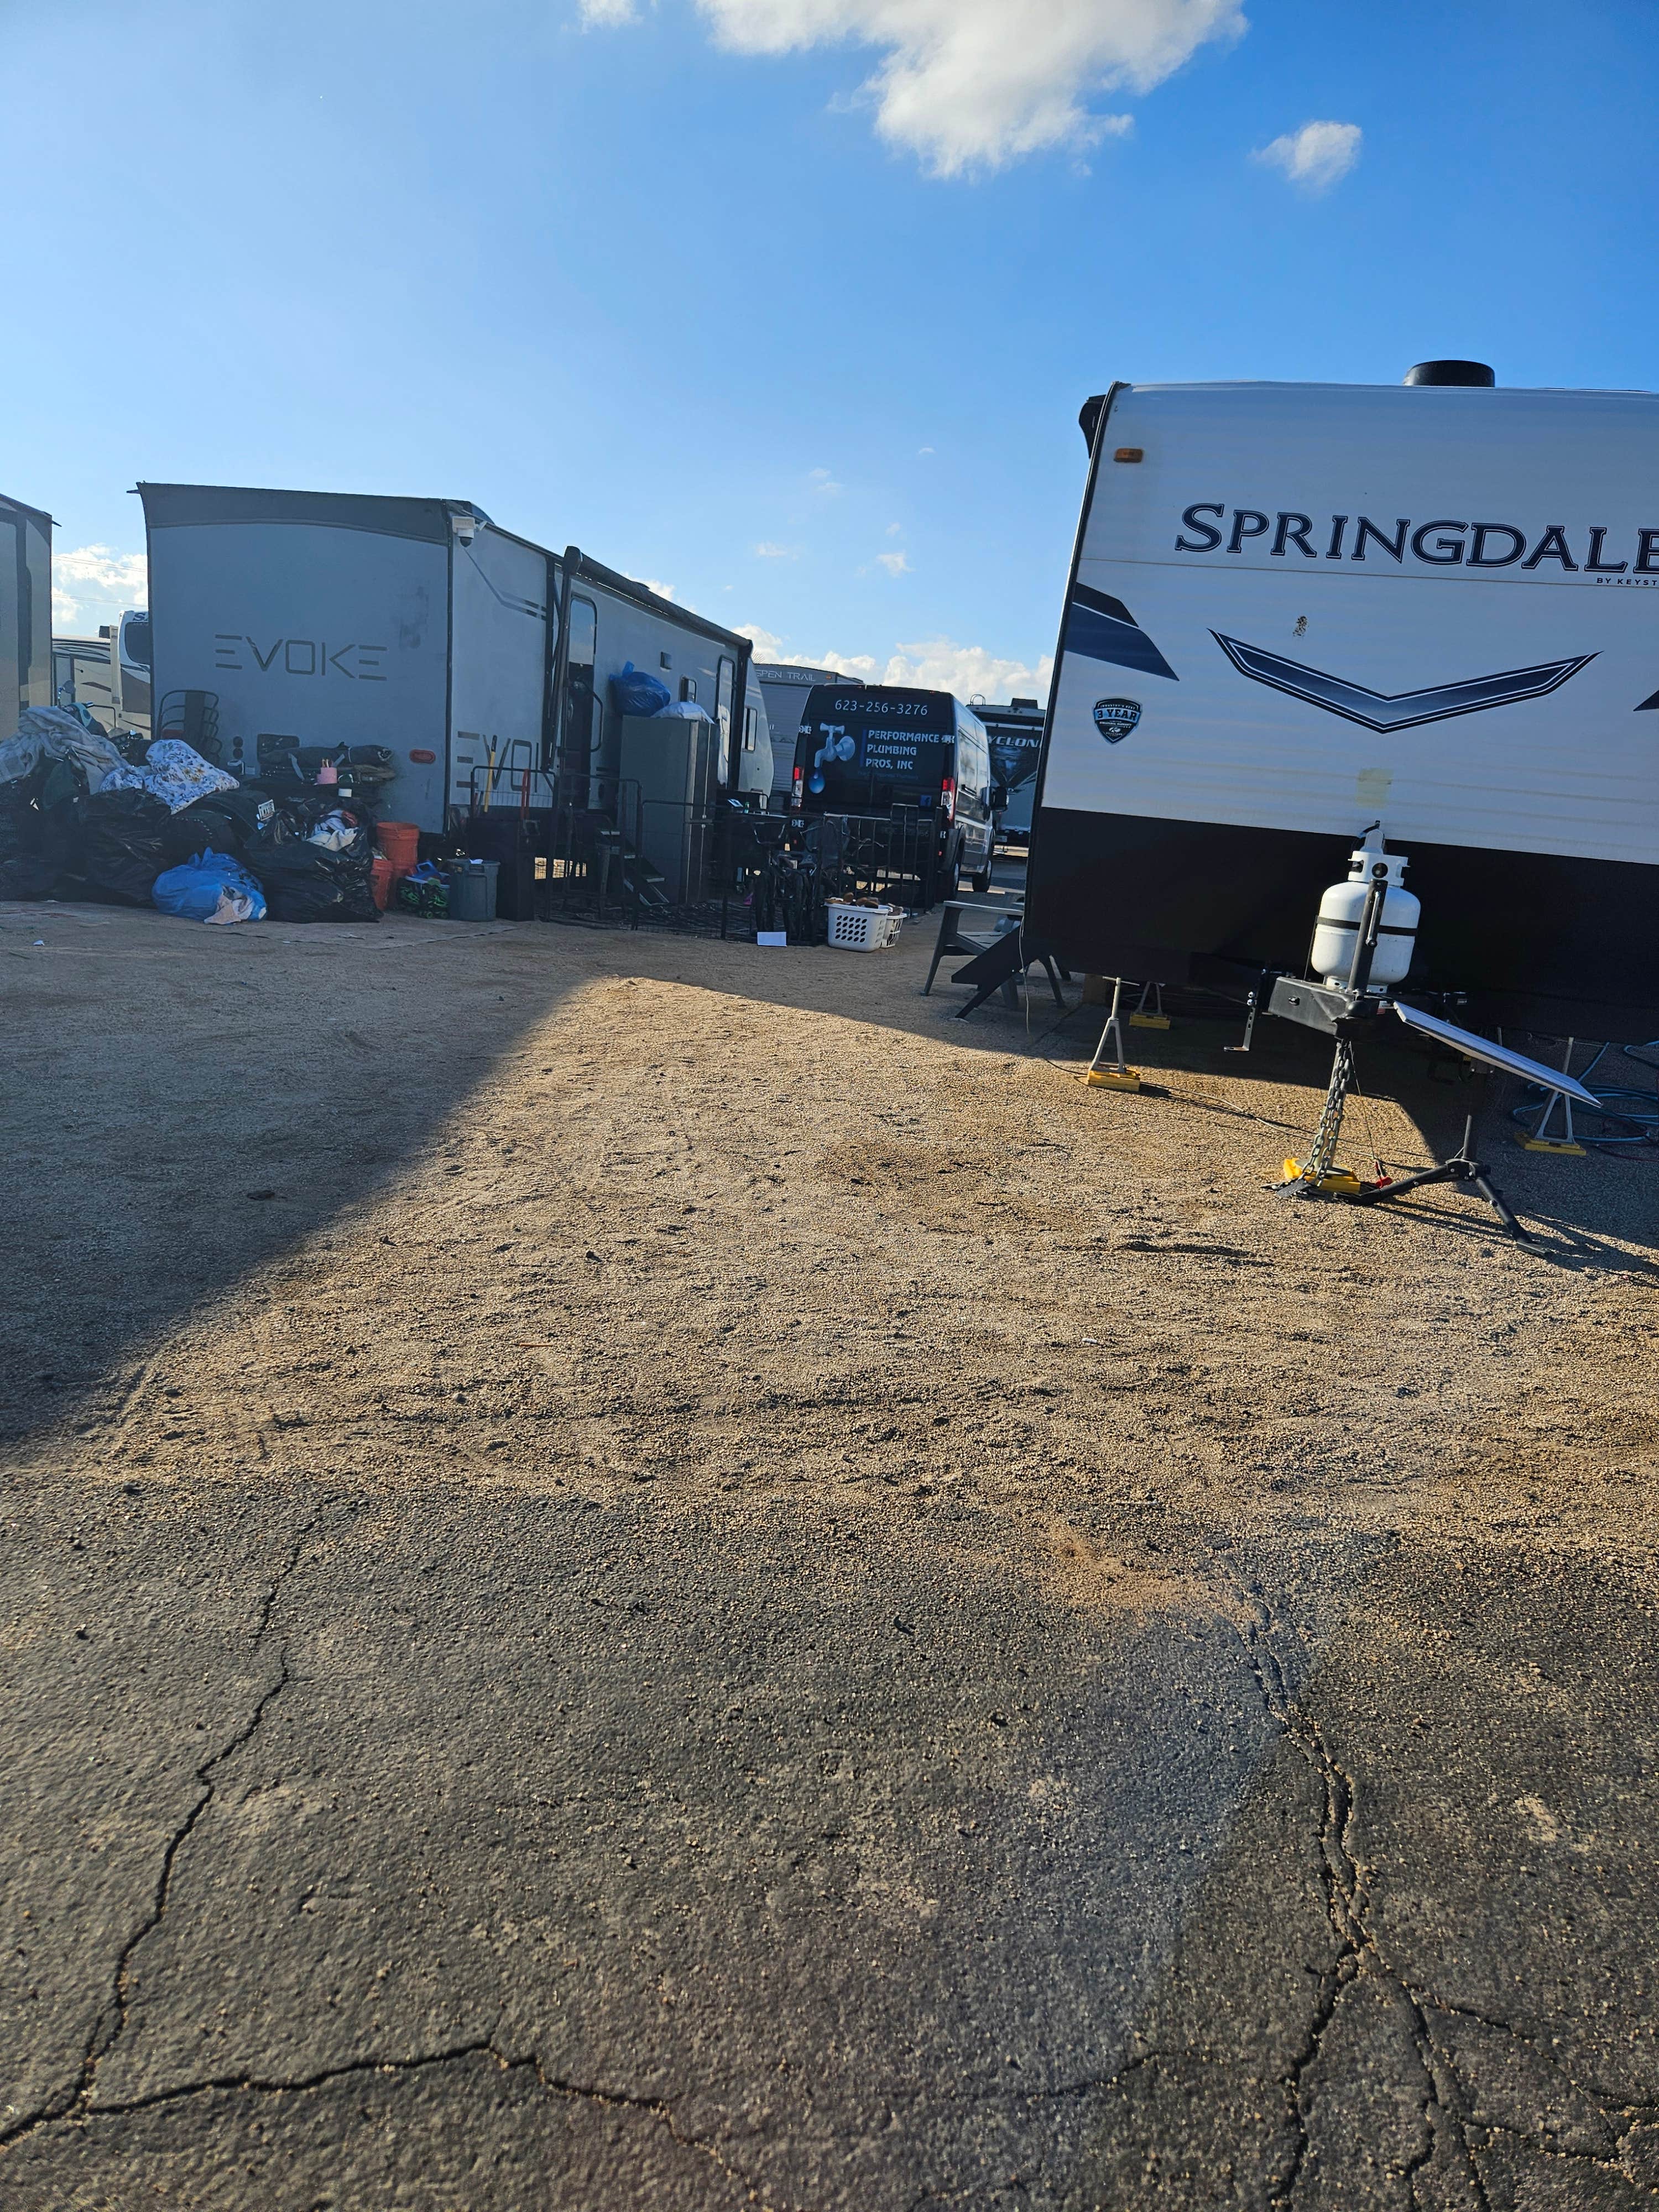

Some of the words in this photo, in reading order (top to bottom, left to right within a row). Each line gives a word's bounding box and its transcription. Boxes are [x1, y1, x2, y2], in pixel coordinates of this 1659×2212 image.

[1175, 503, 1659, 574] SPRINGDALE
[215, 634, 387, 681] EVOKE
[787, 671, 816, 682] TRAIL
[834, 699, 928, 716] 623-256-3276
[1097, 709, 1103, 719] 3
[1107, 708, 1138, 721] YEAR
[868, 729, 940, 743] PERFORMANCE
[867, 743, 917, 756] PLUMBING
[865, 758, 894, 770] PROS,
[896, 760, 914, 770] INC
